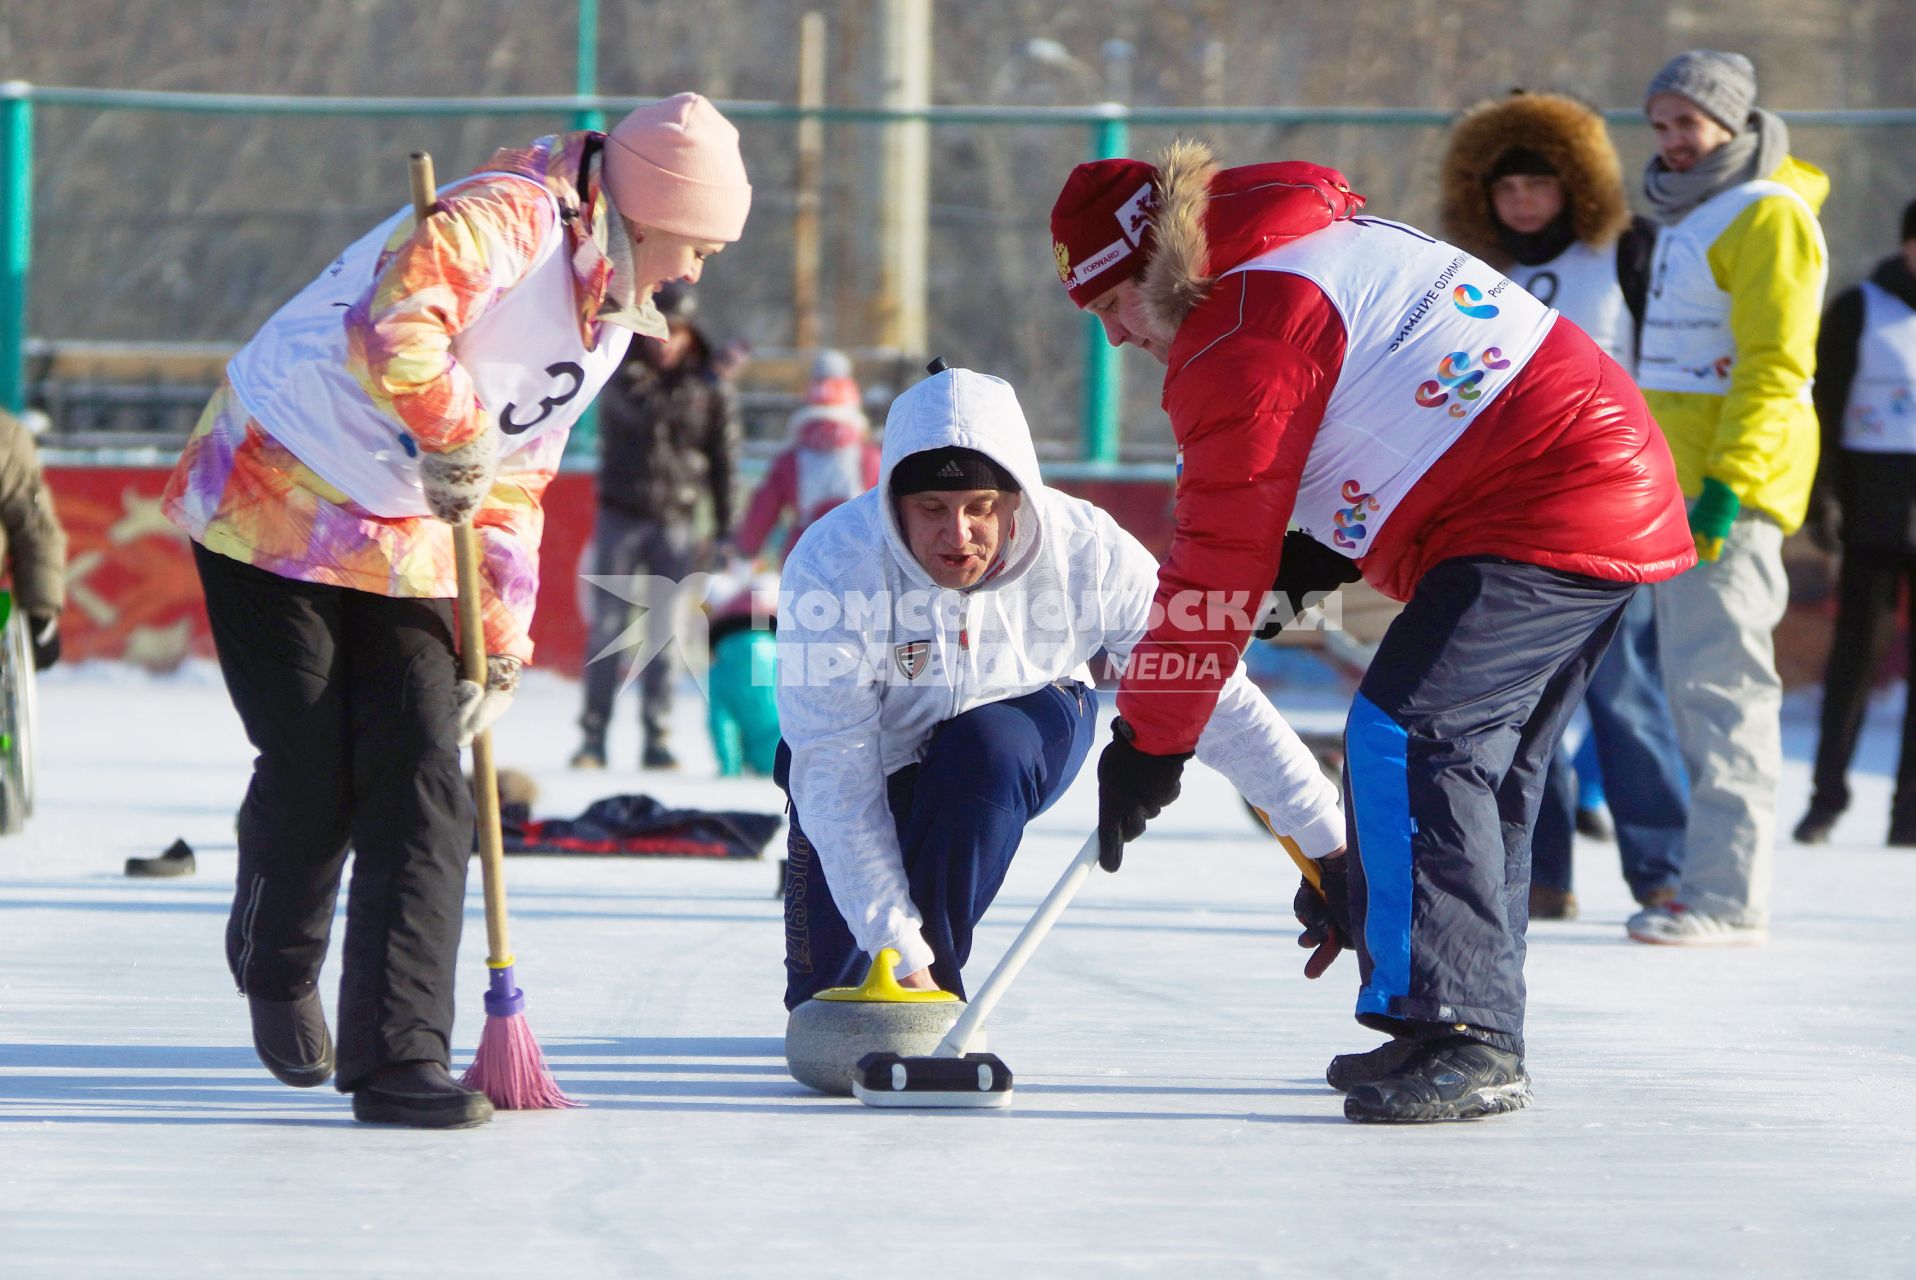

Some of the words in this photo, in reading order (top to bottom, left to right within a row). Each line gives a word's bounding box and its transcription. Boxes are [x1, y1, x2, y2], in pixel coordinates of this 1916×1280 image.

[1082, 250, 1120, 275] FORWARD
[1434, 252, 1471, 291] ОЛИМПИЙ
[1487, 278, 1511, 298] Росте
[499, 361, 585, 435] 3
